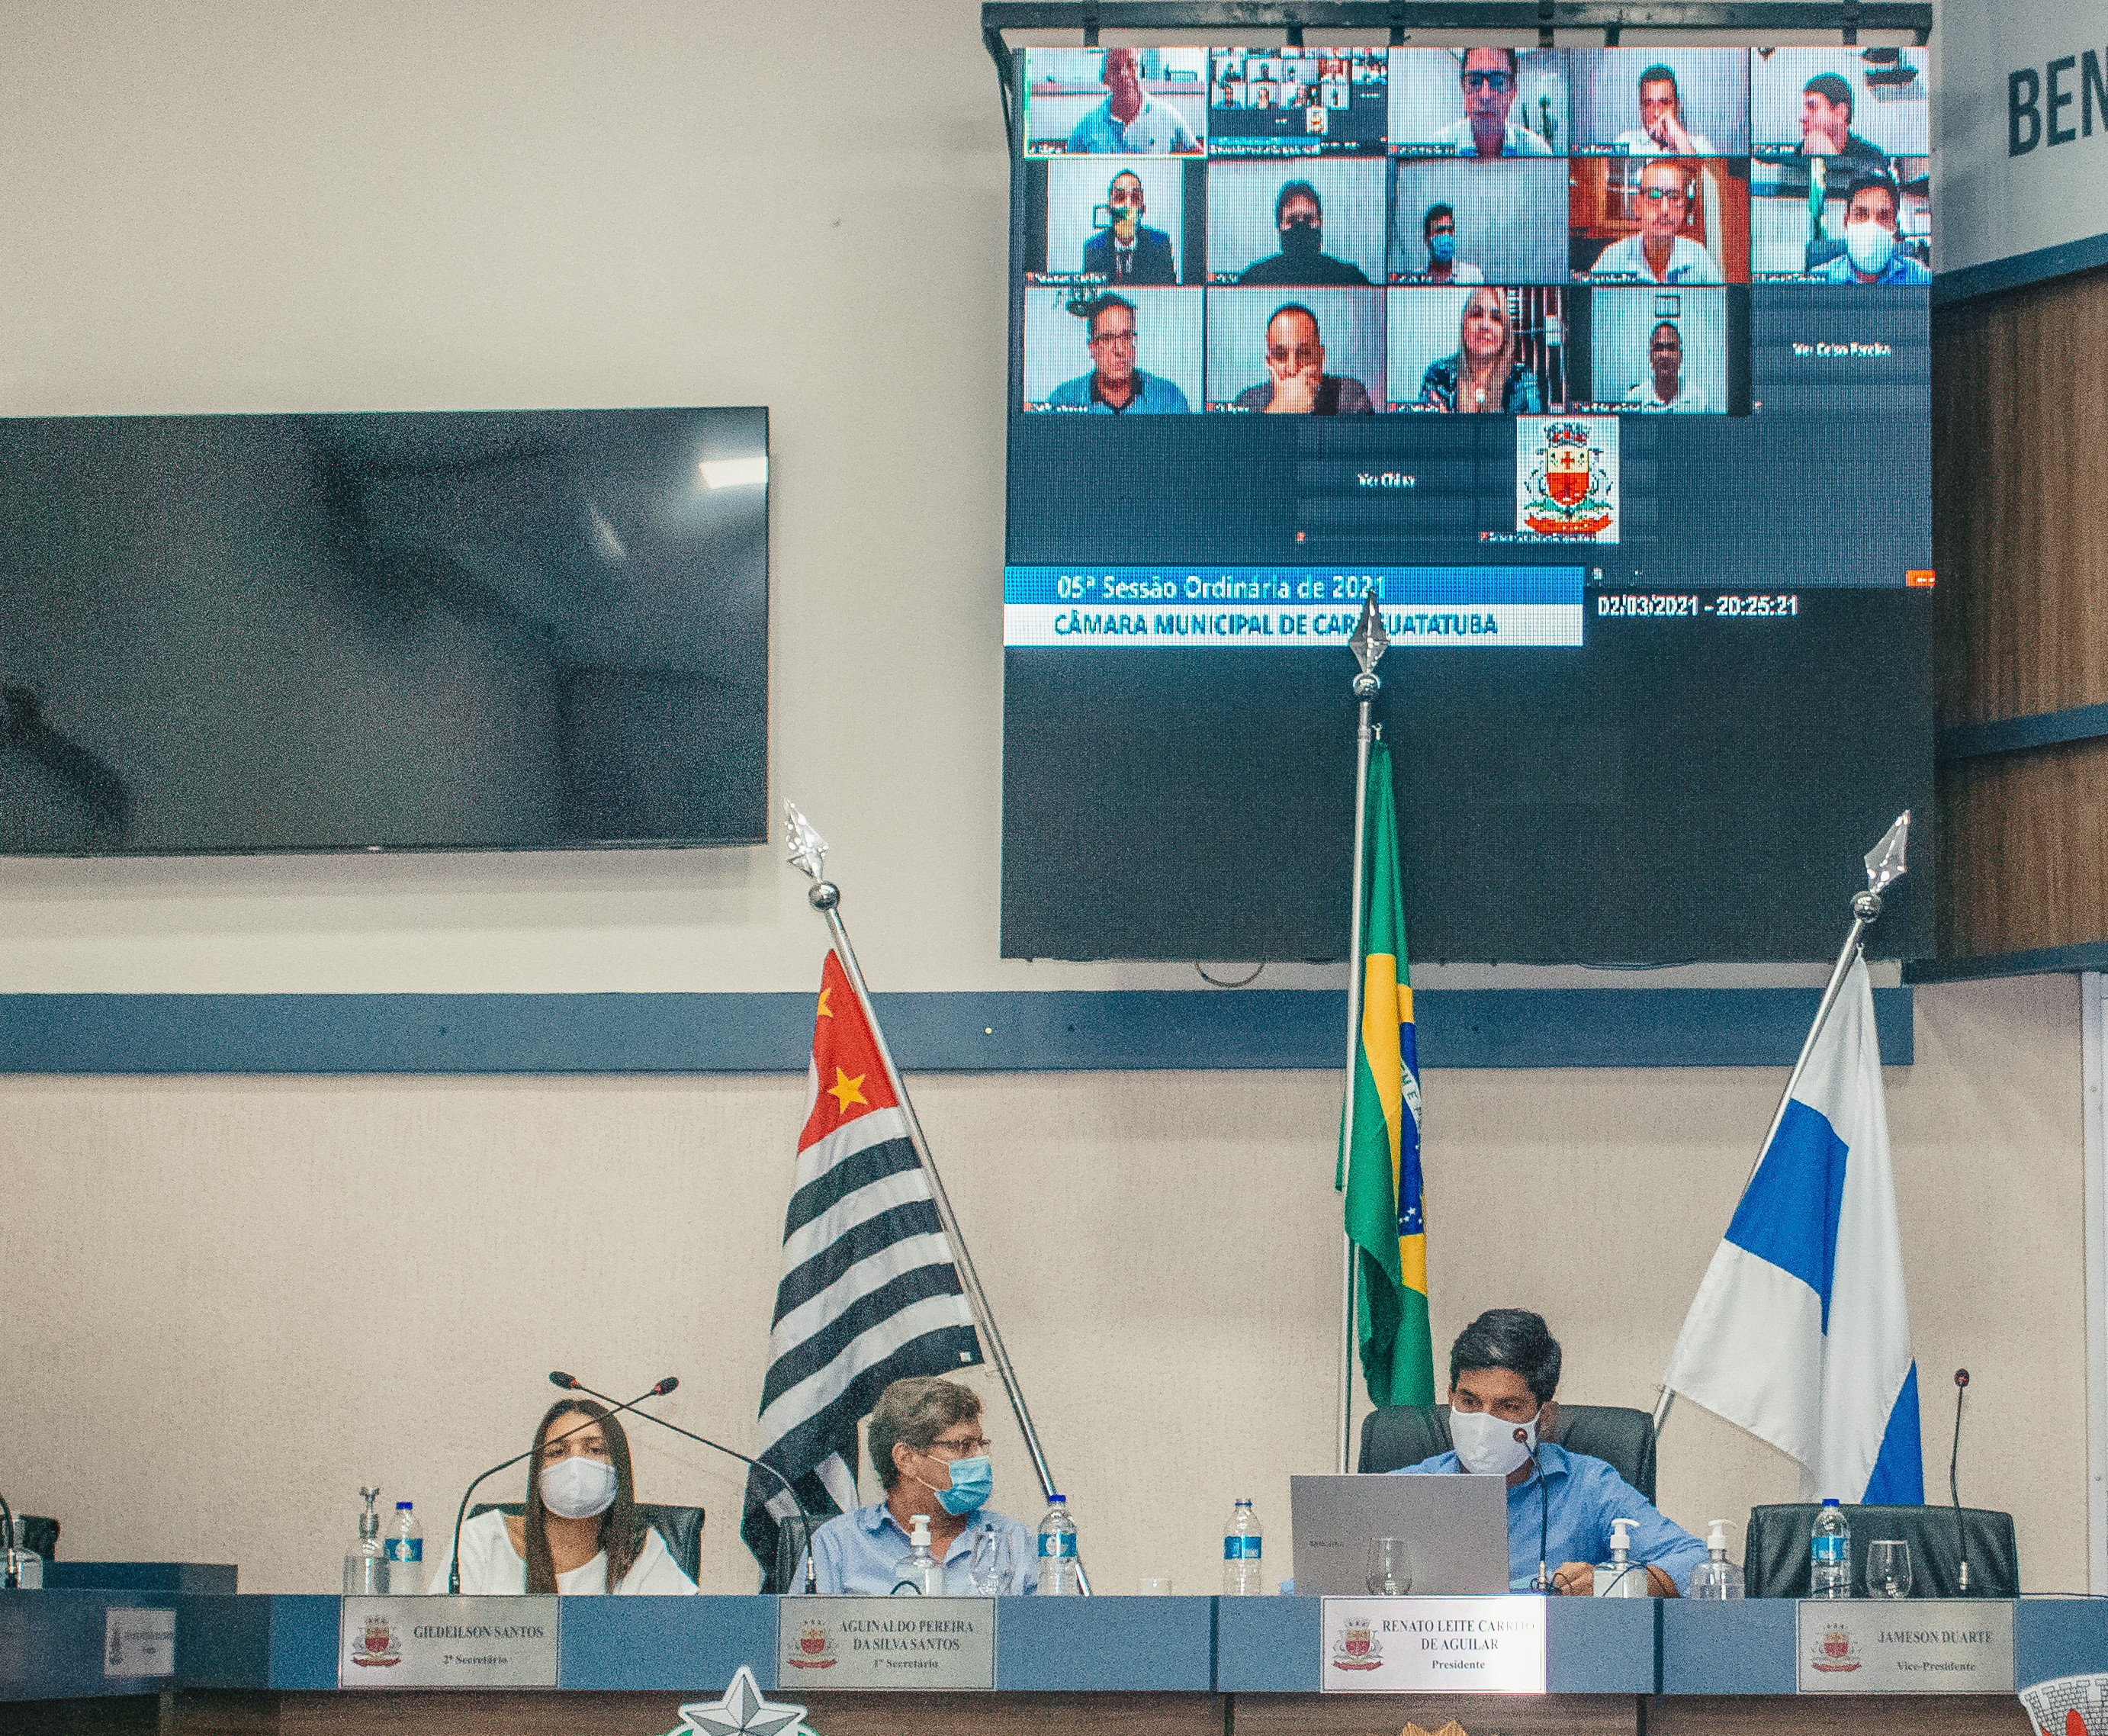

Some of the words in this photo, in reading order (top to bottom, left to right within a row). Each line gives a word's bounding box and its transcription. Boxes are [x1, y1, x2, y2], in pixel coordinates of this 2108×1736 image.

[1102, 574, 1177, 600] Sessão
[1184, 574, 1292, 600] Ordinária
[1297, 575, 1325, 599] de
[1332, 575, 1385, 599] 2021
[1598, 594, 1699, 617] 02/03/2021
[1716, 595, 1798, 617] 20:25:21
[1054, 609, 1148, 636] CÂMARA
[1155, 613, 1274, 636] MUNICIPAL
[1281, 613, 1308, 635] DE
[1313, 613, 1499, 636] CARUATATUBA
[413, 1625, 490, 1638] GILDEILSON
[494, 1626, 545, 1638] SANTOS
[840, 1620, 915, 1633] AGUINALDO
[919, 1620, 974, 1633] PEREIRA
[1382, 1619, 1434, 1633] RENATO
[1438, 1620, 1475, 1632] LEITE
[1878, 1631, 1940, 1644] JAMESON
[1943, 1631, 1994, 1644] DUARTE
[873, 1638, 908, 1651] SILVA
[909, 1638, 960, 1651] SANTOS
[1422, 1638, 1438, 1651] DE
[1441, 1638, 1499, 1651] AGUILAR
[1432, 1659, 1486, 1670] Presidente
[1897, 1661, 1976, 1672] Vice-Presidente
